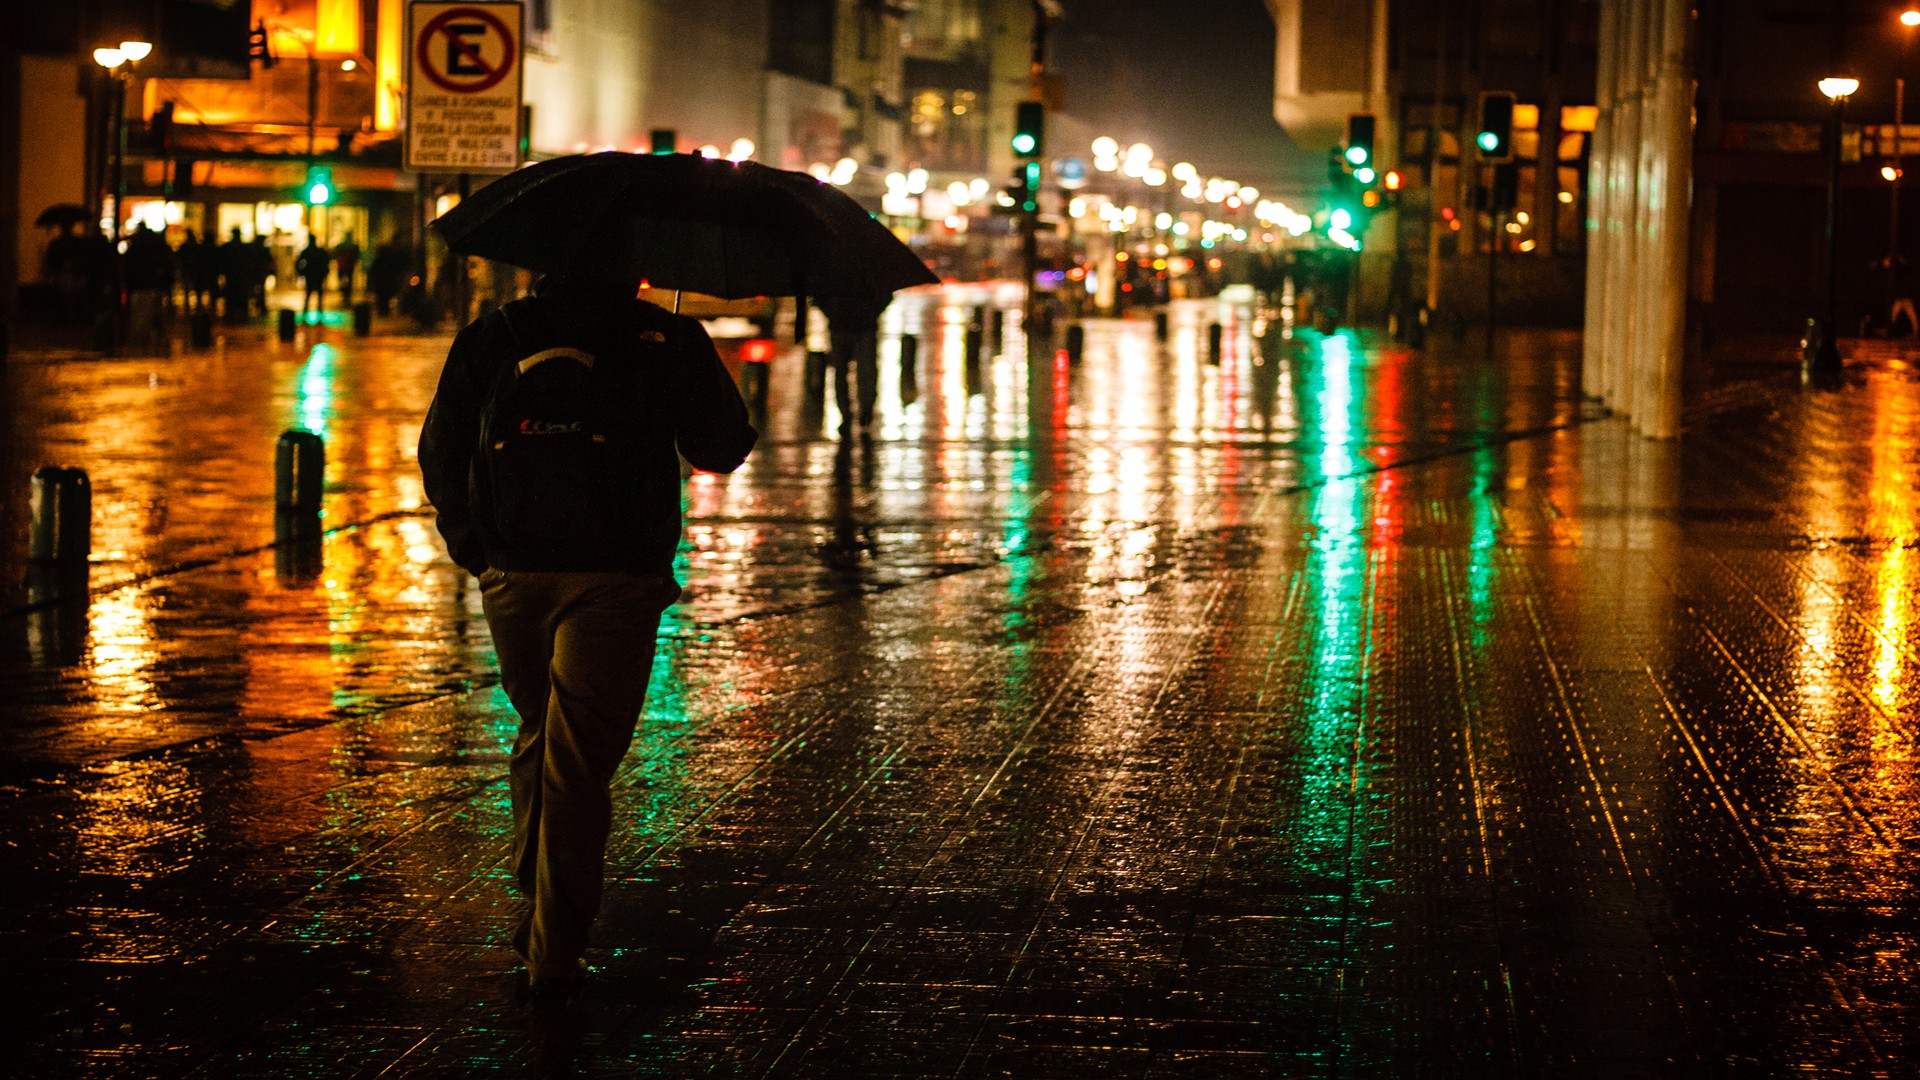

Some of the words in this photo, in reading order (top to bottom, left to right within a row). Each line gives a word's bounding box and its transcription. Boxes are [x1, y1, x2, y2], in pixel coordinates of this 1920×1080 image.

[448, 25, 487, 75] E
[414, 95, 447, 107] LUNES
[462, 96, 513, 108] DOMINGO
[442, 109, 495, 121] FESTIVOS
[464, 124, 512, 135] CUADRA
